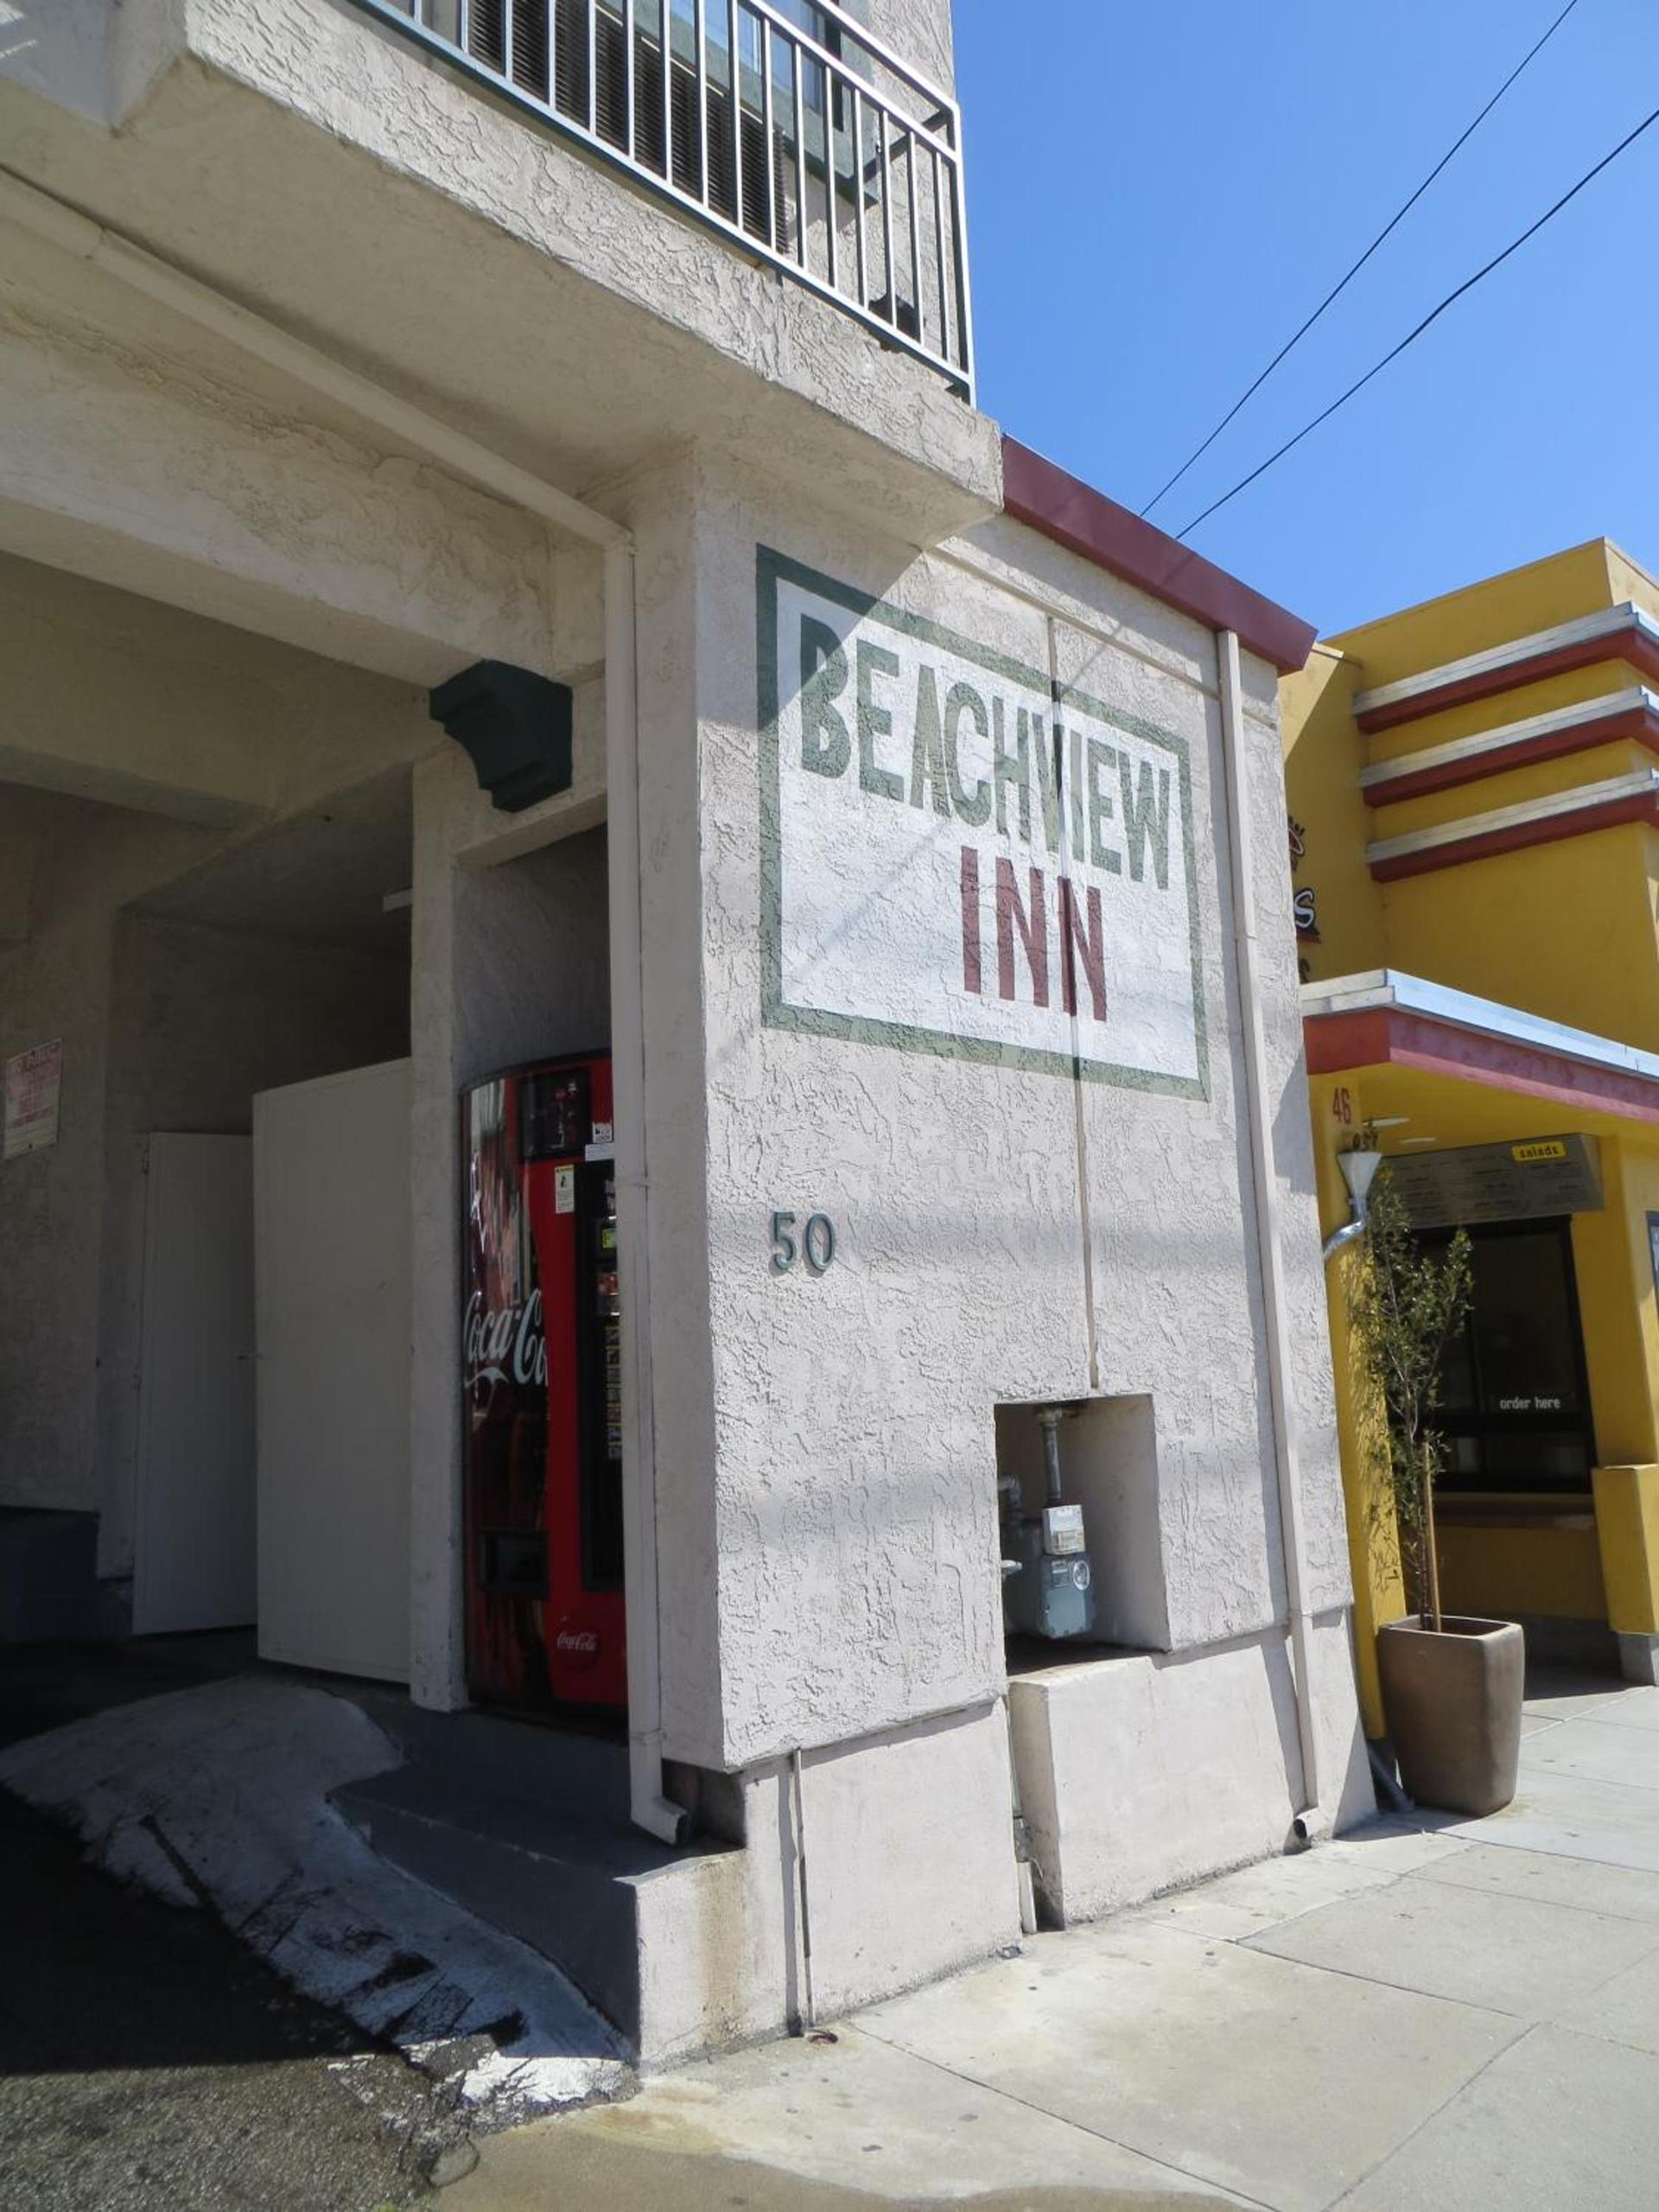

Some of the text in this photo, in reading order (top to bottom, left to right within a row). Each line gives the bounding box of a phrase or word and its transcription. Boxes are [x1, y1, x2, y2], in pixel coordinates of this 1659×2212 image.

[799, 614, 1171, 890] BEACHVIEW
[960, 845, 1108, 1021] INN
[1332, 1087, 1351, 1124] 46
[772, 1211, 835, 1272] 50
[1500, 1395, 1560, 1409] order here
